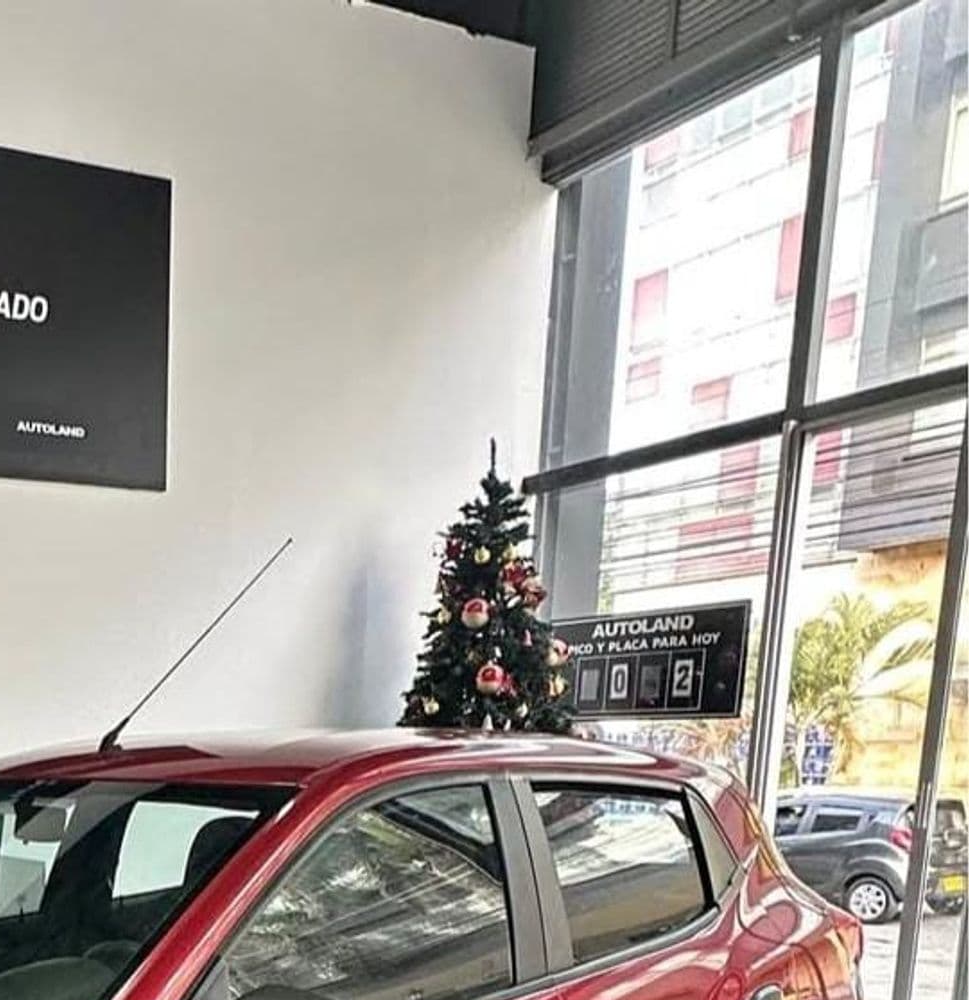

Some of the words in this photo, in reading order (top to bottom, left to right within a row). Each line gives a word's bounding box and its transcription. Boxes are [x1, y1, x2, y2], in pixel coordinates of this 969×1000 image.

[16, 420, 86, 439] AUTOLAND
[592, 614, 694, 639] AUTOLAND
[597, 642, 605, 653] Y
[609, 638, 648, 652] PLACA
[652, 635, 687, 649] PARA
[692, 631, 721, 646] HOY
[614, 666, 626, 694] 0
[675, 664, 691, 692] 2
